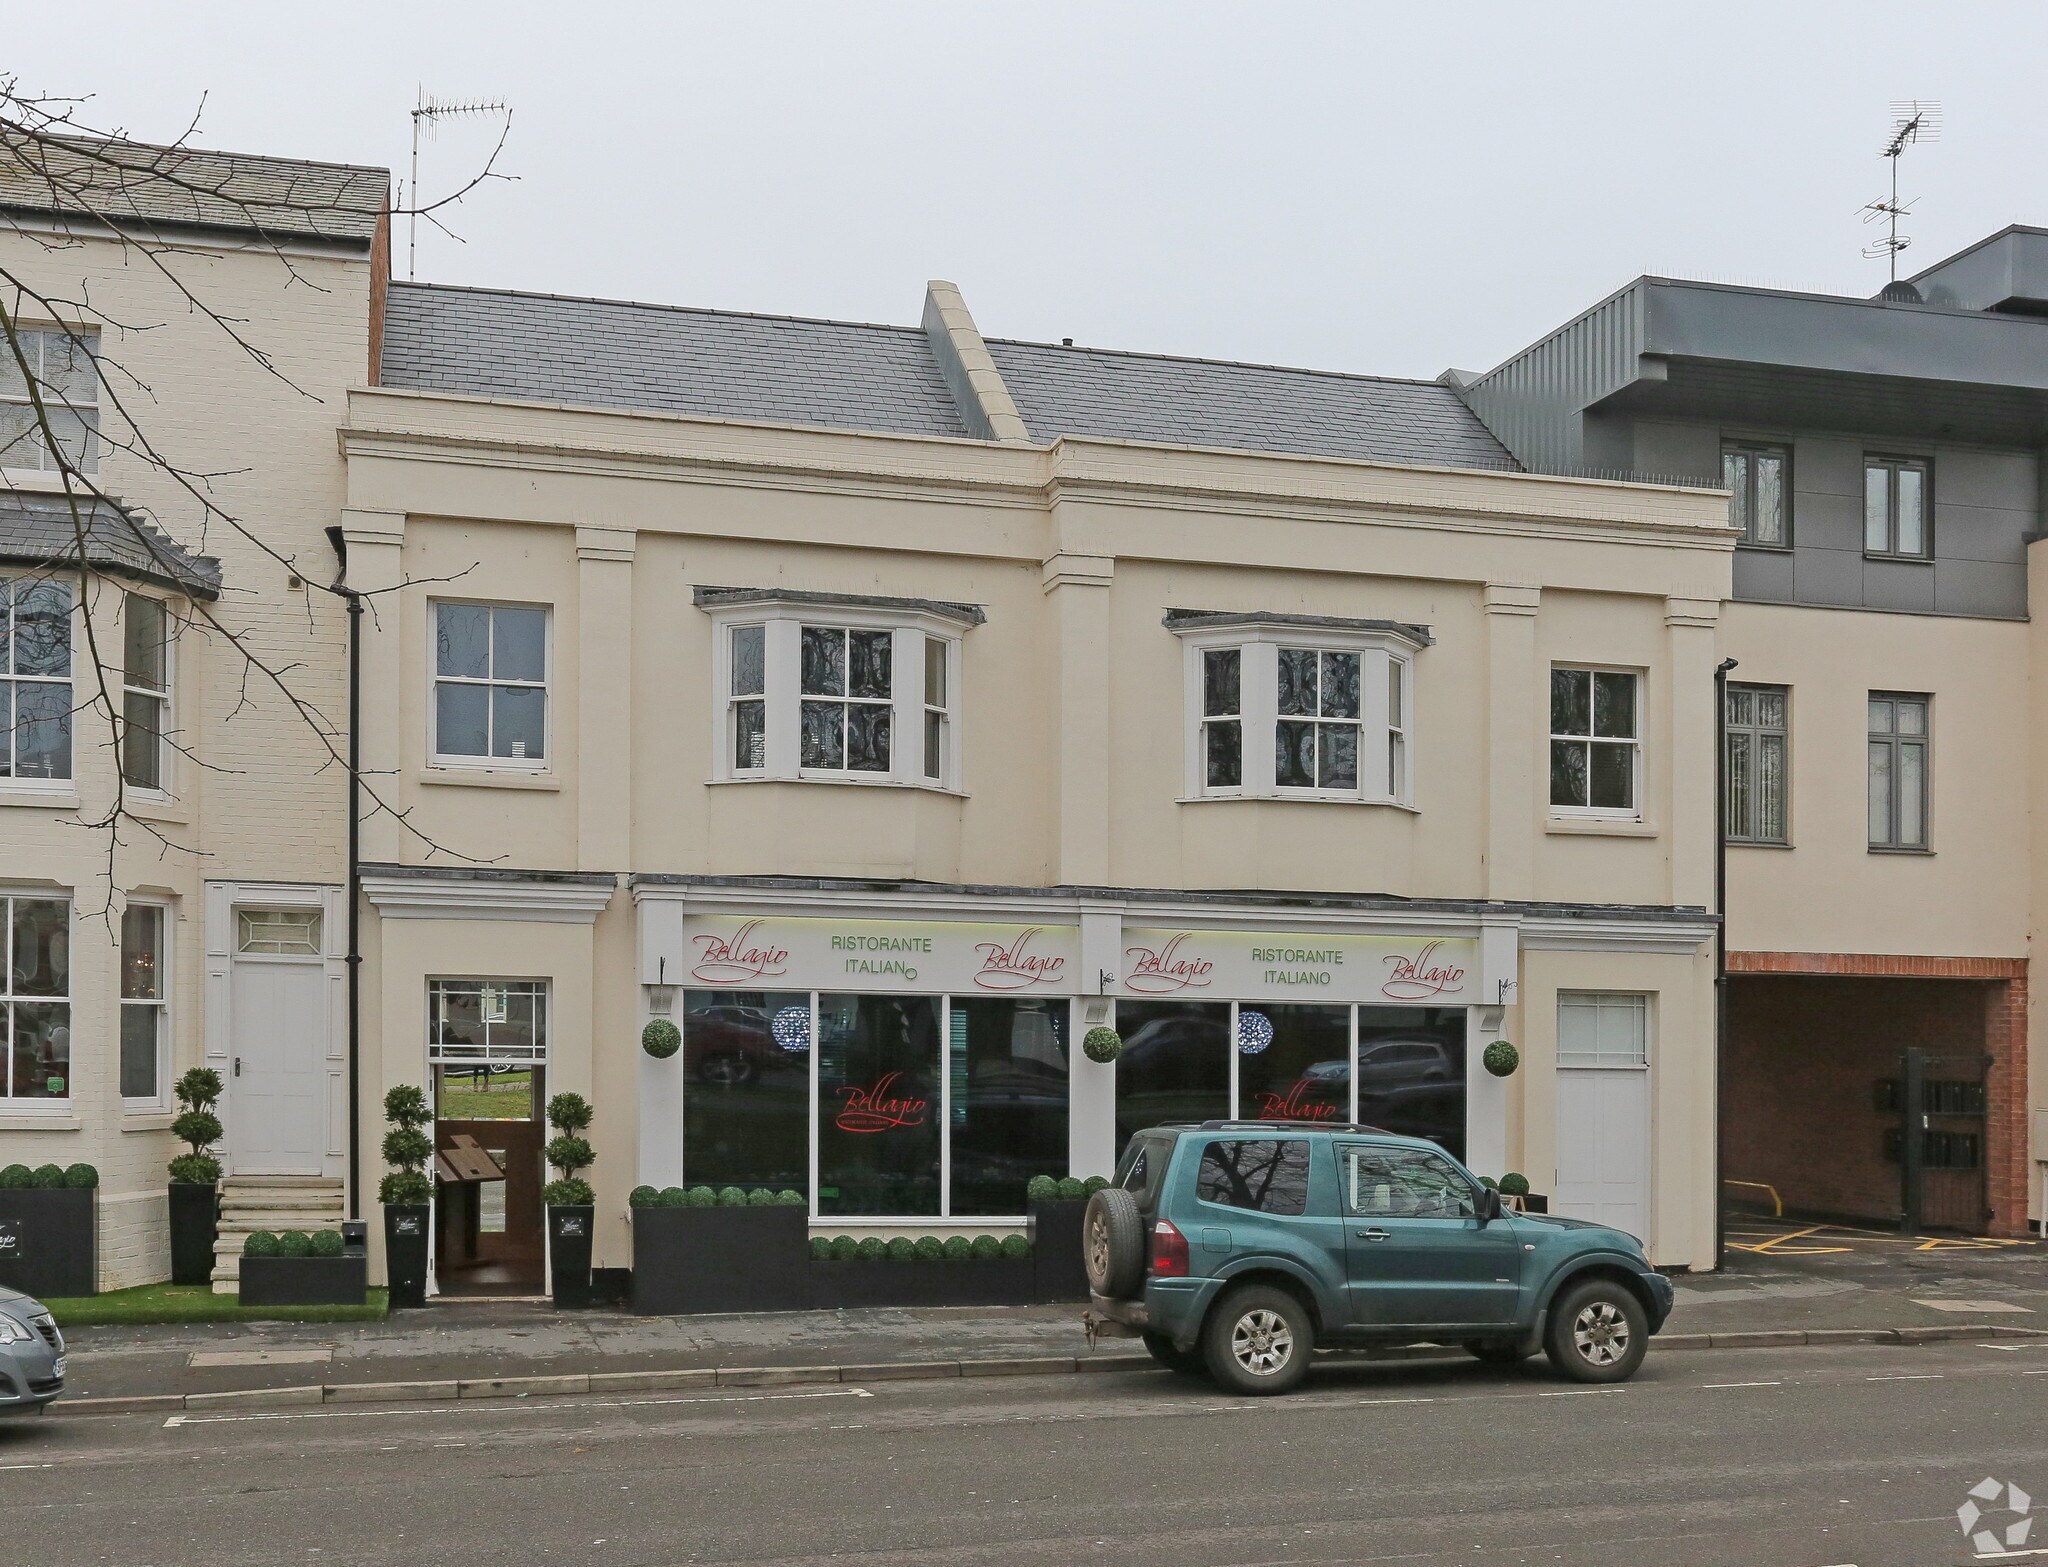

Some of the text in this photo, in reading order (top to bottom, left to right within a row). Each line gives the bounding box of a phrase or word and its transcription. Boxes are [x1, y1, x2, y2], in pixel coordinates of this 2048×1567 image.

[691, 919, 789, 983] Bellagio
[831, 935, 932, 953] RISTORANTE
[973, 927, 1064, 989] Bellagio
[1124, 932, 1213, 993] Bellagio
[1252, 948, 1343, 965] RISTORANTE
[1381, 940, 1464, 999] Bellagio
[845, 959, 918, 981] ITALIANO
[1264, 970, 1331, 985] ITALIANO
[835, 1071, 926, 1133] Bellagio
[1254, 1077, 1338, 1121] Bellagio
